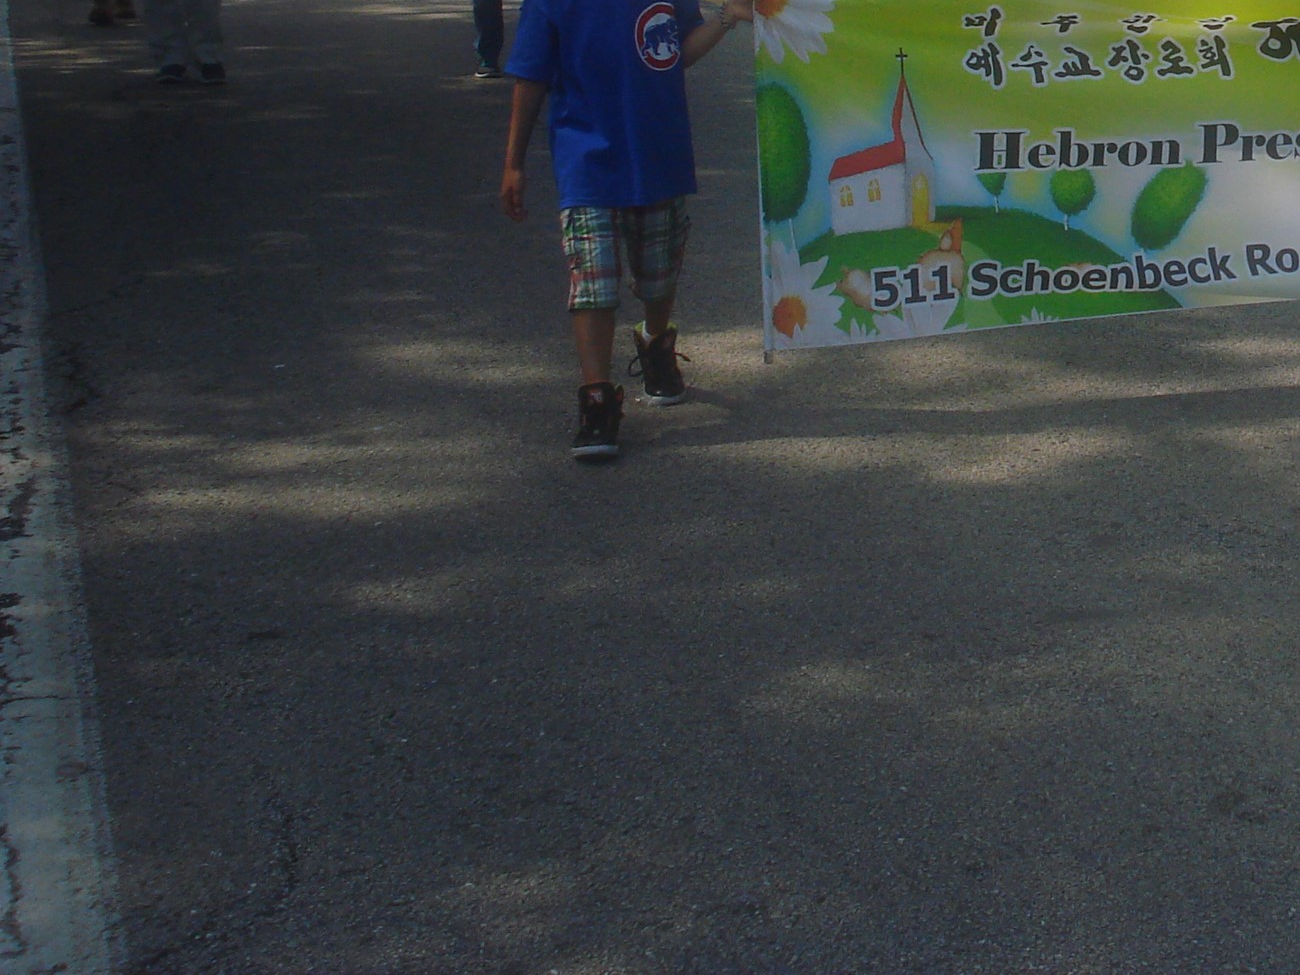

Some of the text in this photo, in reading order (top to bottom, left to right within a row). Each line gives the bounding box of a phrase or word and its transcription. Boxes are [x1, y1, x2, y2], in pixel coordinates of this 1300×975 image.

[965, 35, 1232, 86] 예수교장로회
[975, 129, 1182, 172] Hebron
[872, 264, 956, 308] 511
[970, 246, 1238, 297] Schoenbeck
